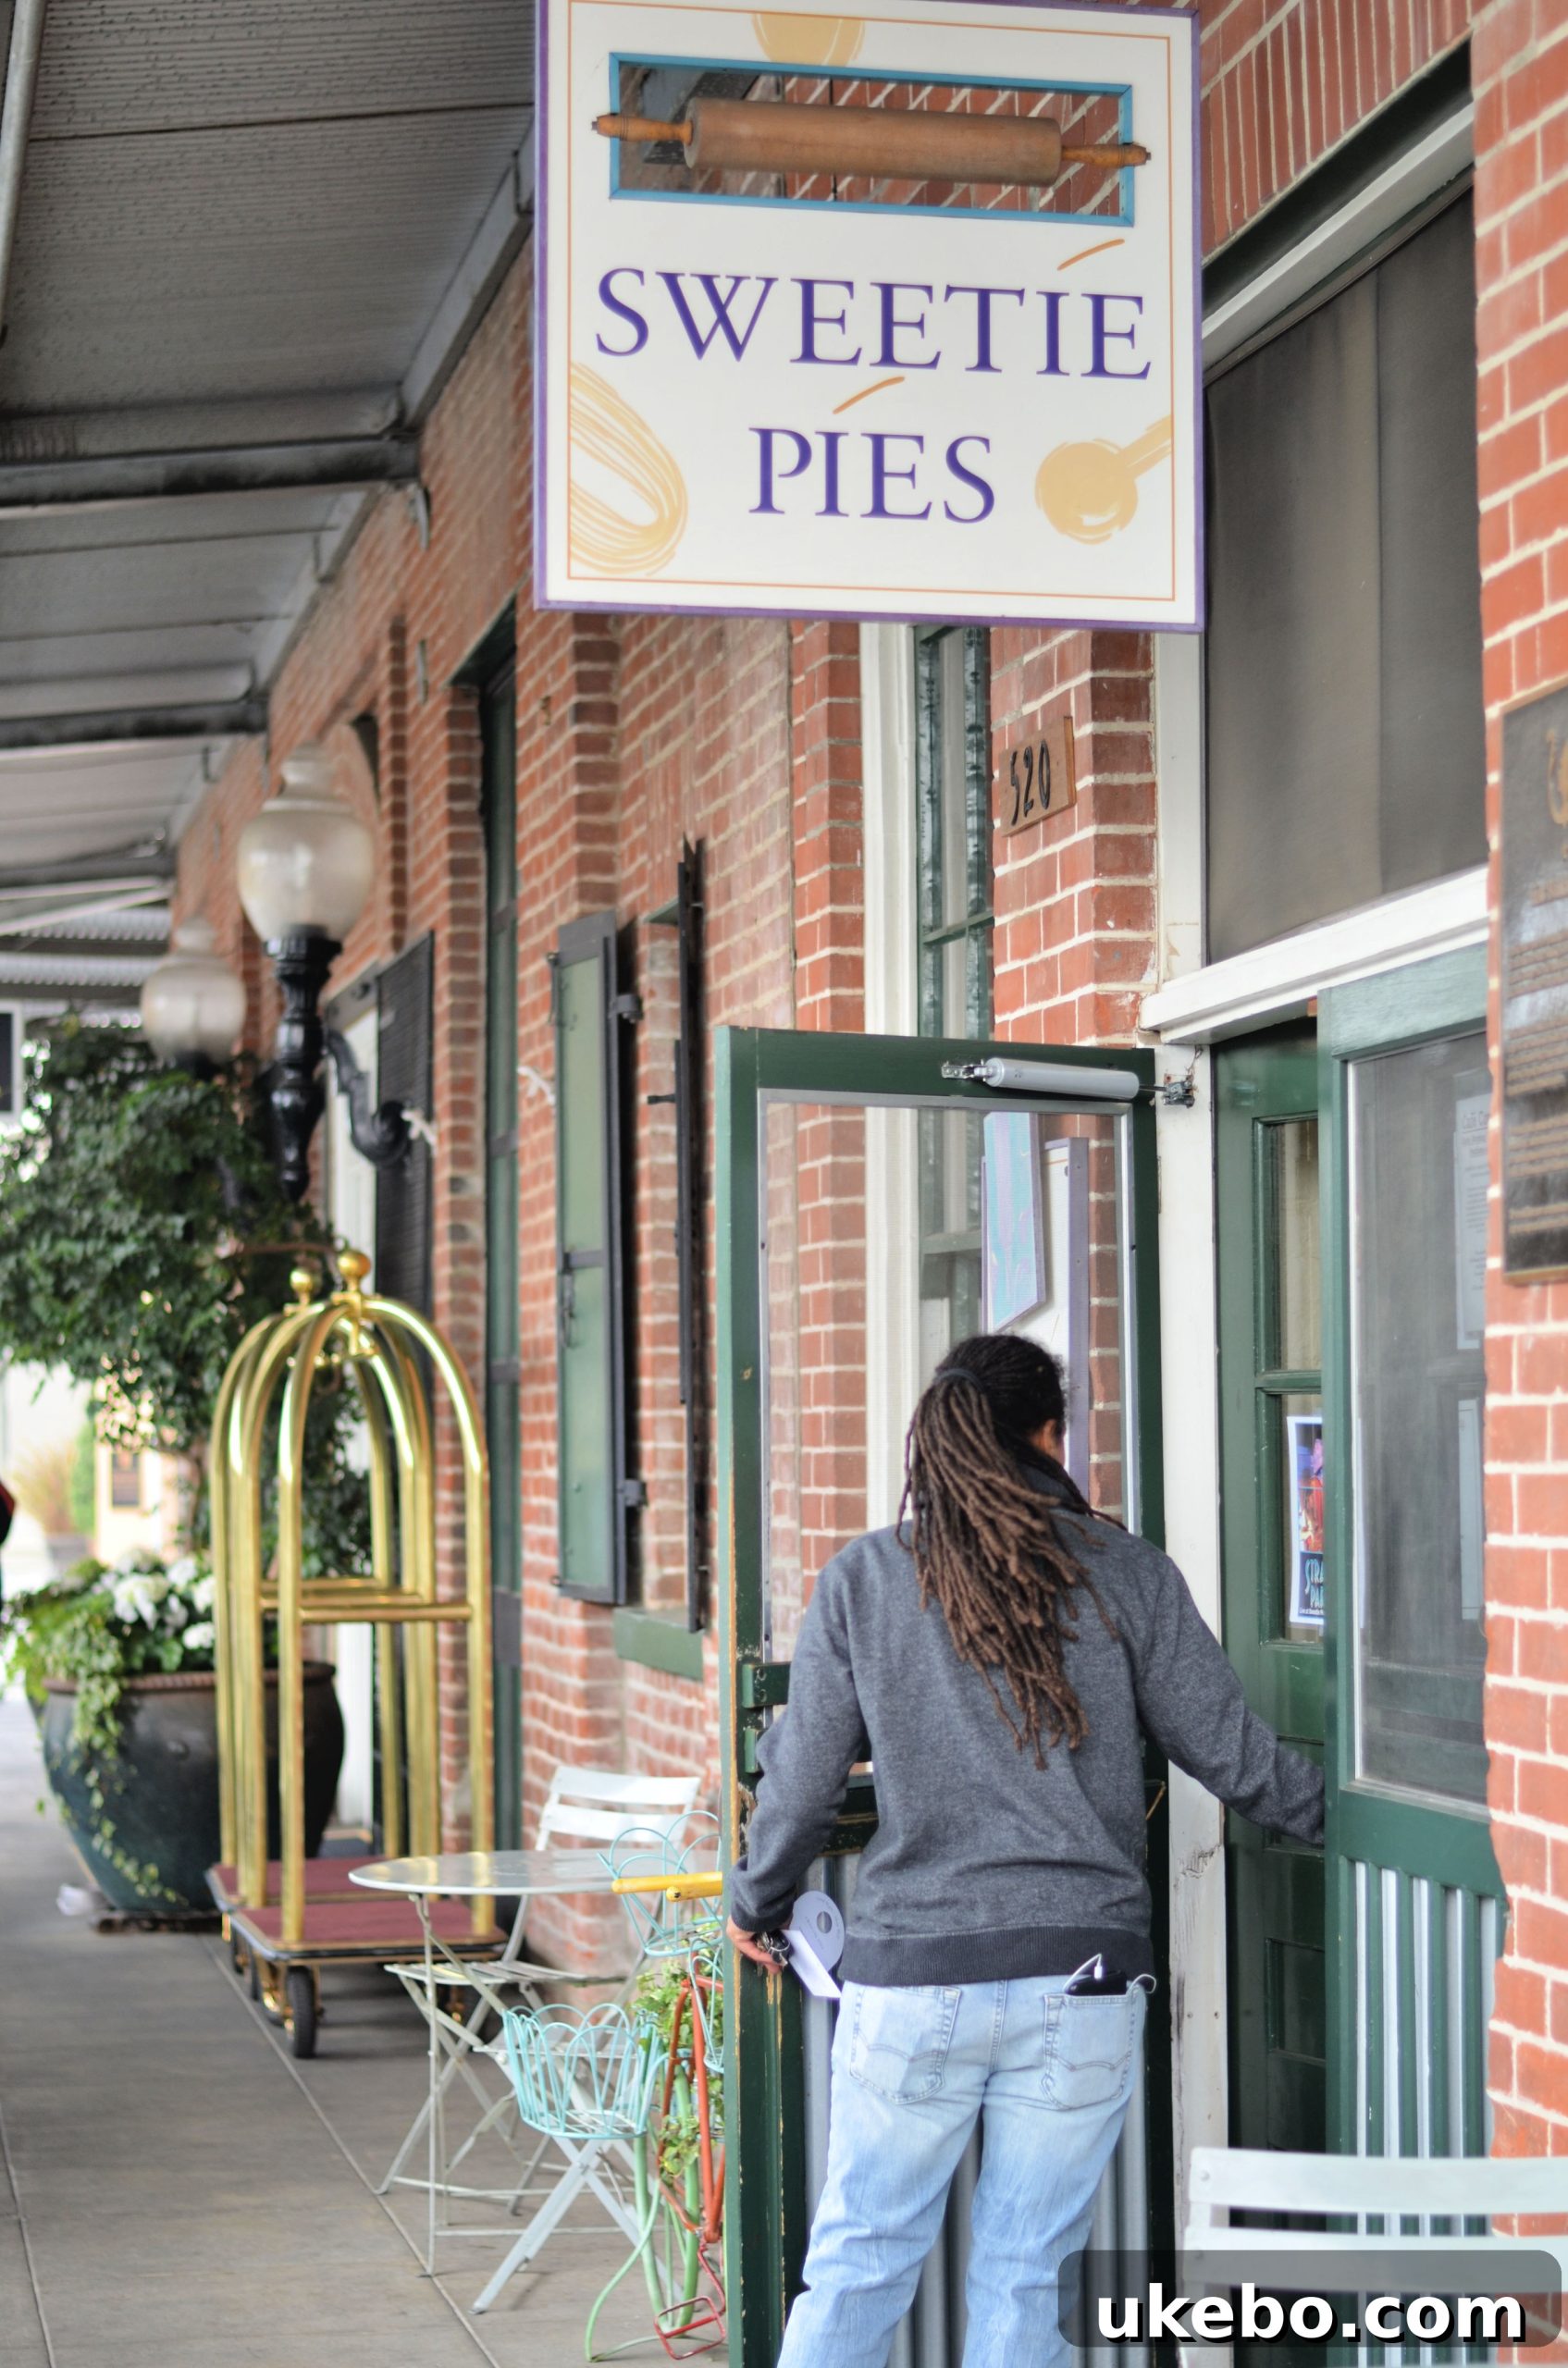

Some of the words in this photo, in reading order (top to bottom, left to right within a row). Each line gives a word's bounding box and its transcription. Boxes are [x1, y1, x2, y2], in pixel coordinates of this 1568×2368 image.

[595, 267, 1152, 380] SWEETIE
[747, 426, 996, 524] PIES
[1010, 739, 1051, 826] 520
